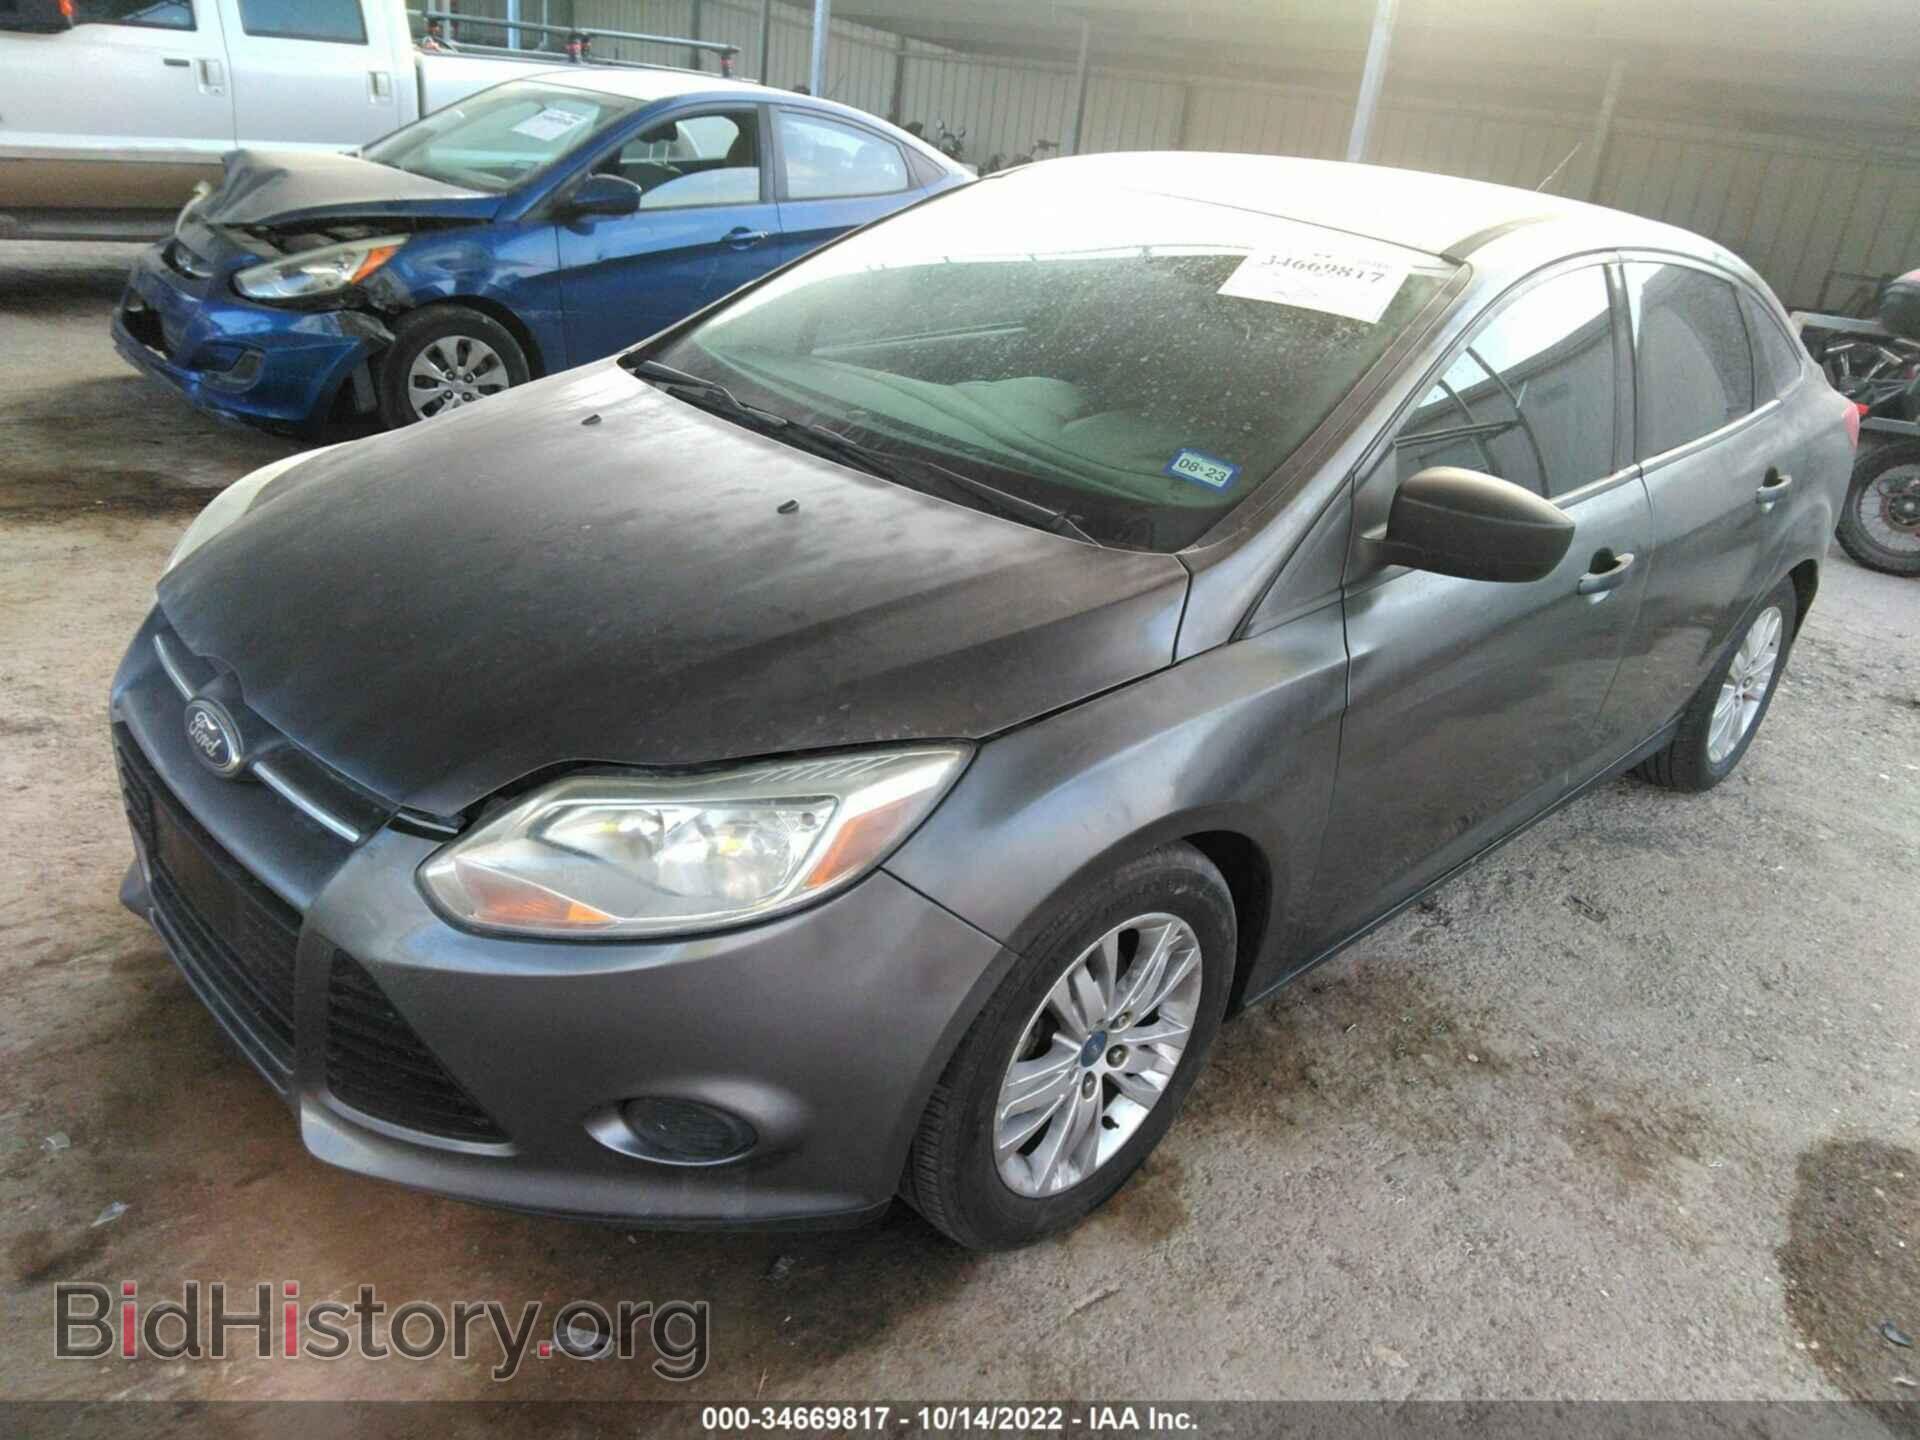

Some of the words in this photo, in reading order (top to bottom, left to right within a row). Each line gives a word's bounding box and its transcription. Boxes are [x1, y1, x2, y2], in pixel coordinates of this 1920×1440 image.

[1178, 458, 1200, 473] 08
[1205, 467, 1227, 482] 23
[188, 711, 221, 757] Ford
